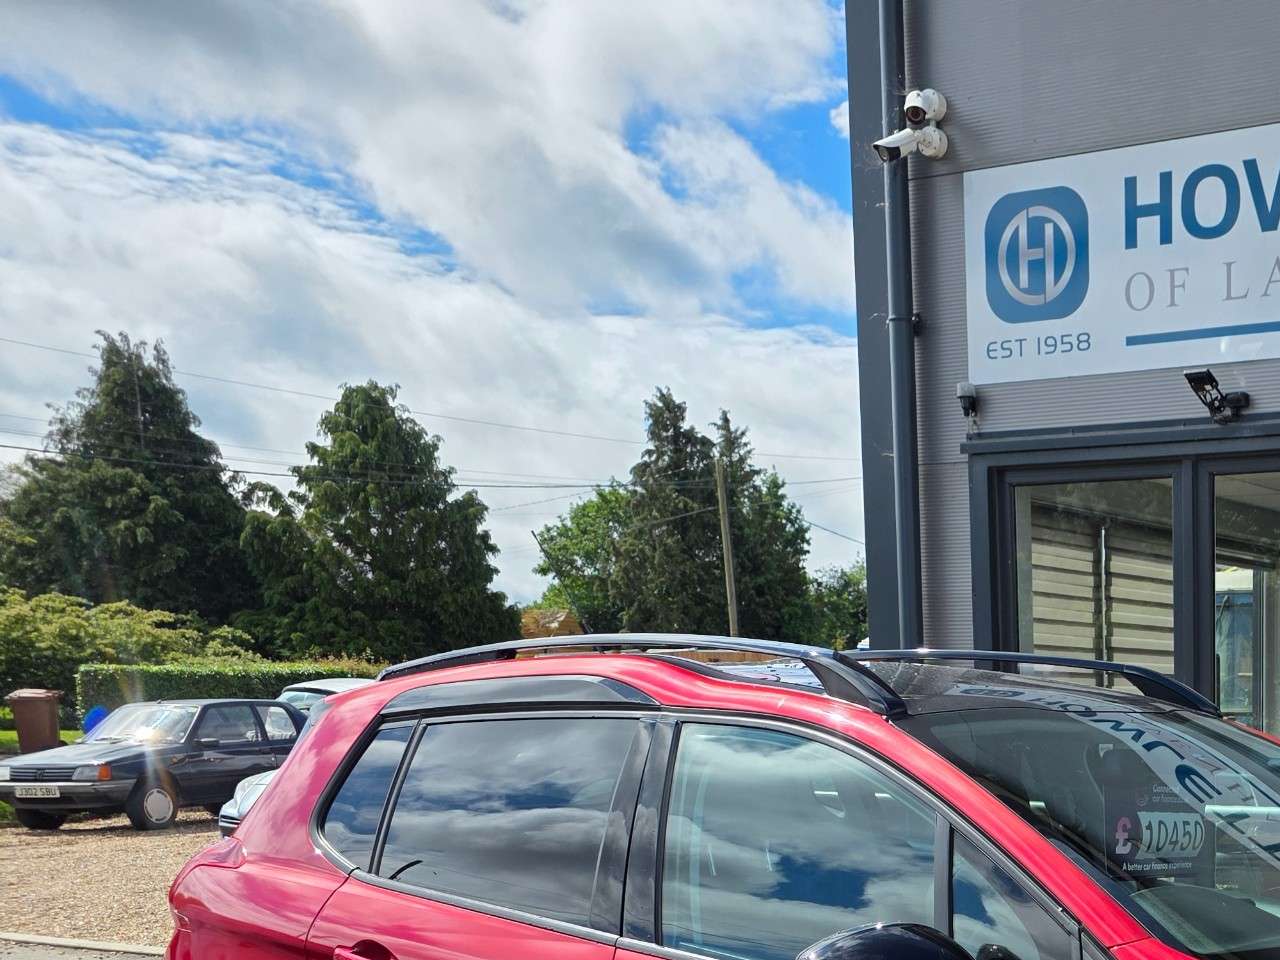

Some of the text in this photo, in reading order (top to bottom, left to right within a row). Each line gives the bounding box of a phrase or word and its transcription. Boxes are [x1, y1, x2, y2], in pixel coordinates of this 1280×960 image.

[1125, 267, 1191, 313] OF
[986, 332, 1091, 360] EST 1958
